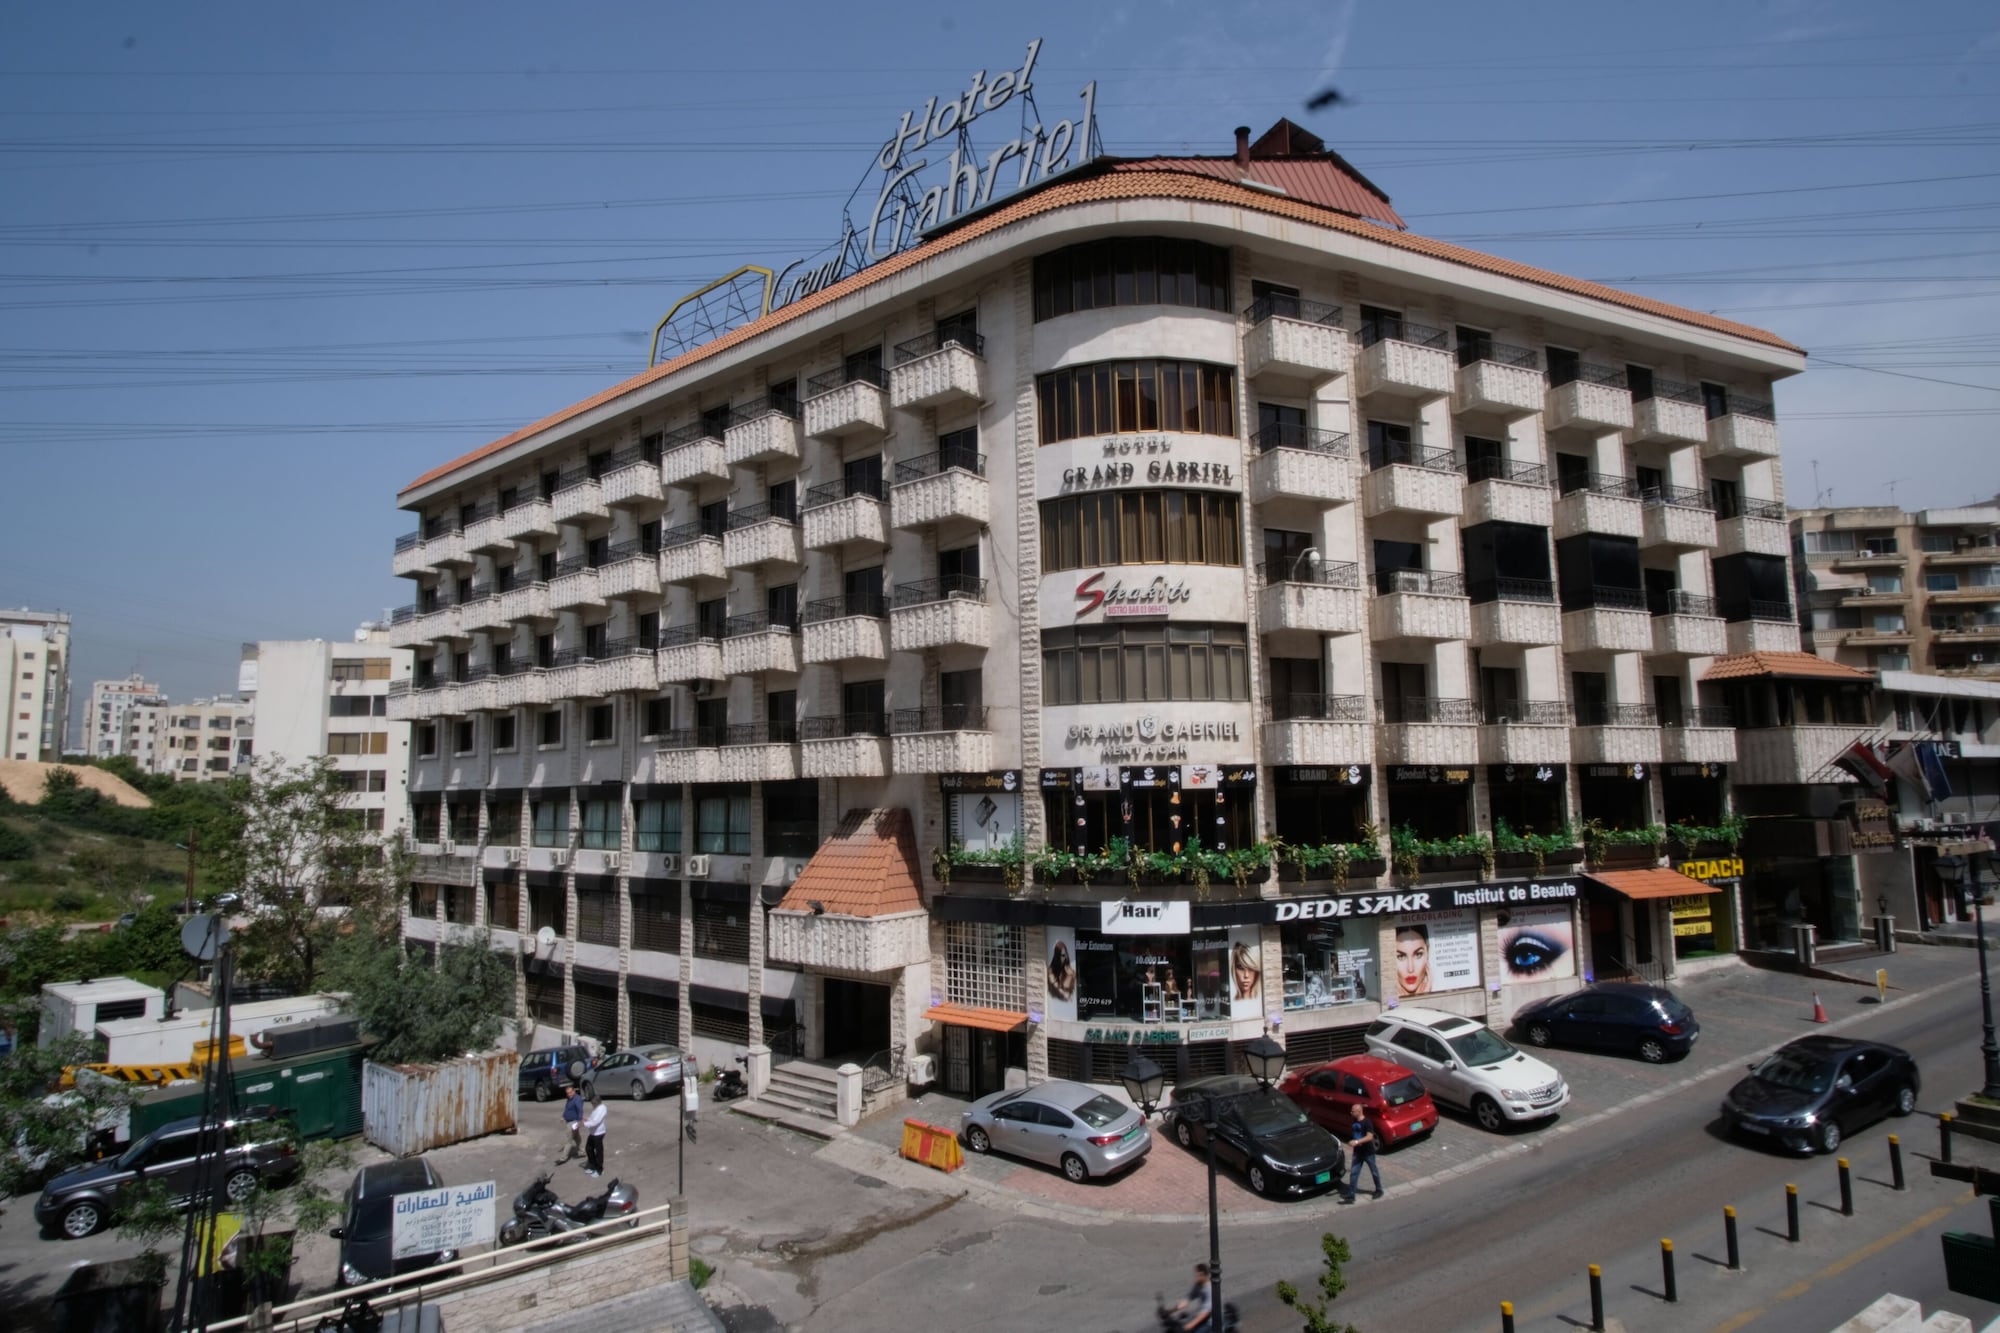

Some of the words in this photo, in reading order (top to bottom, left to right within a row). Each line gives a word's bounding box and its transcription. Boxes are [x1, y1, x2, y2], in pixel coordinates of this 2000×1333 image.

[880, 37, 1043, 171] Hotel
[867, 80, 1096, 262] Gabriel
[1103, 437, 1173, 458] HOTEL
[1062, 462, 1134, 488] GRAND
[1149, 460, 1233, 485] GABRIEL
[1107, 606, 1128, 615] BISTRO
[1066, 722, 1135, 745] GRAND
[1162, 720, 1239, 742] GABRIEL
[1101, 744, 1141, 762] RENT
[1156, 744, 1188, 760] CAR
[1299, 768, 1328, 781] GRAND
[1682, 858, 1744, 880] COACH
[1453, 886, 1504, 906] Institut
[1508, 883, 1526, 901] de
[1530, 880, 1577, 899] Beaute
[1122, 905, 1161, 918] Hair
[1275, 898, 1353, 922] DEDE
[1356, 891, 1431, 915] SAKR
[1400, 910, 1463, 923] MICROBLADING
[1132, 1029, 1182, 1042] GABRIEL
[1190, 1030, 1208, 1039] RENT
[1215, 1028, 1230, 1037] CAR
[397, 1191, 449, 1214] للعقارات
[456, 1184, 494, 1207] الشيخ
